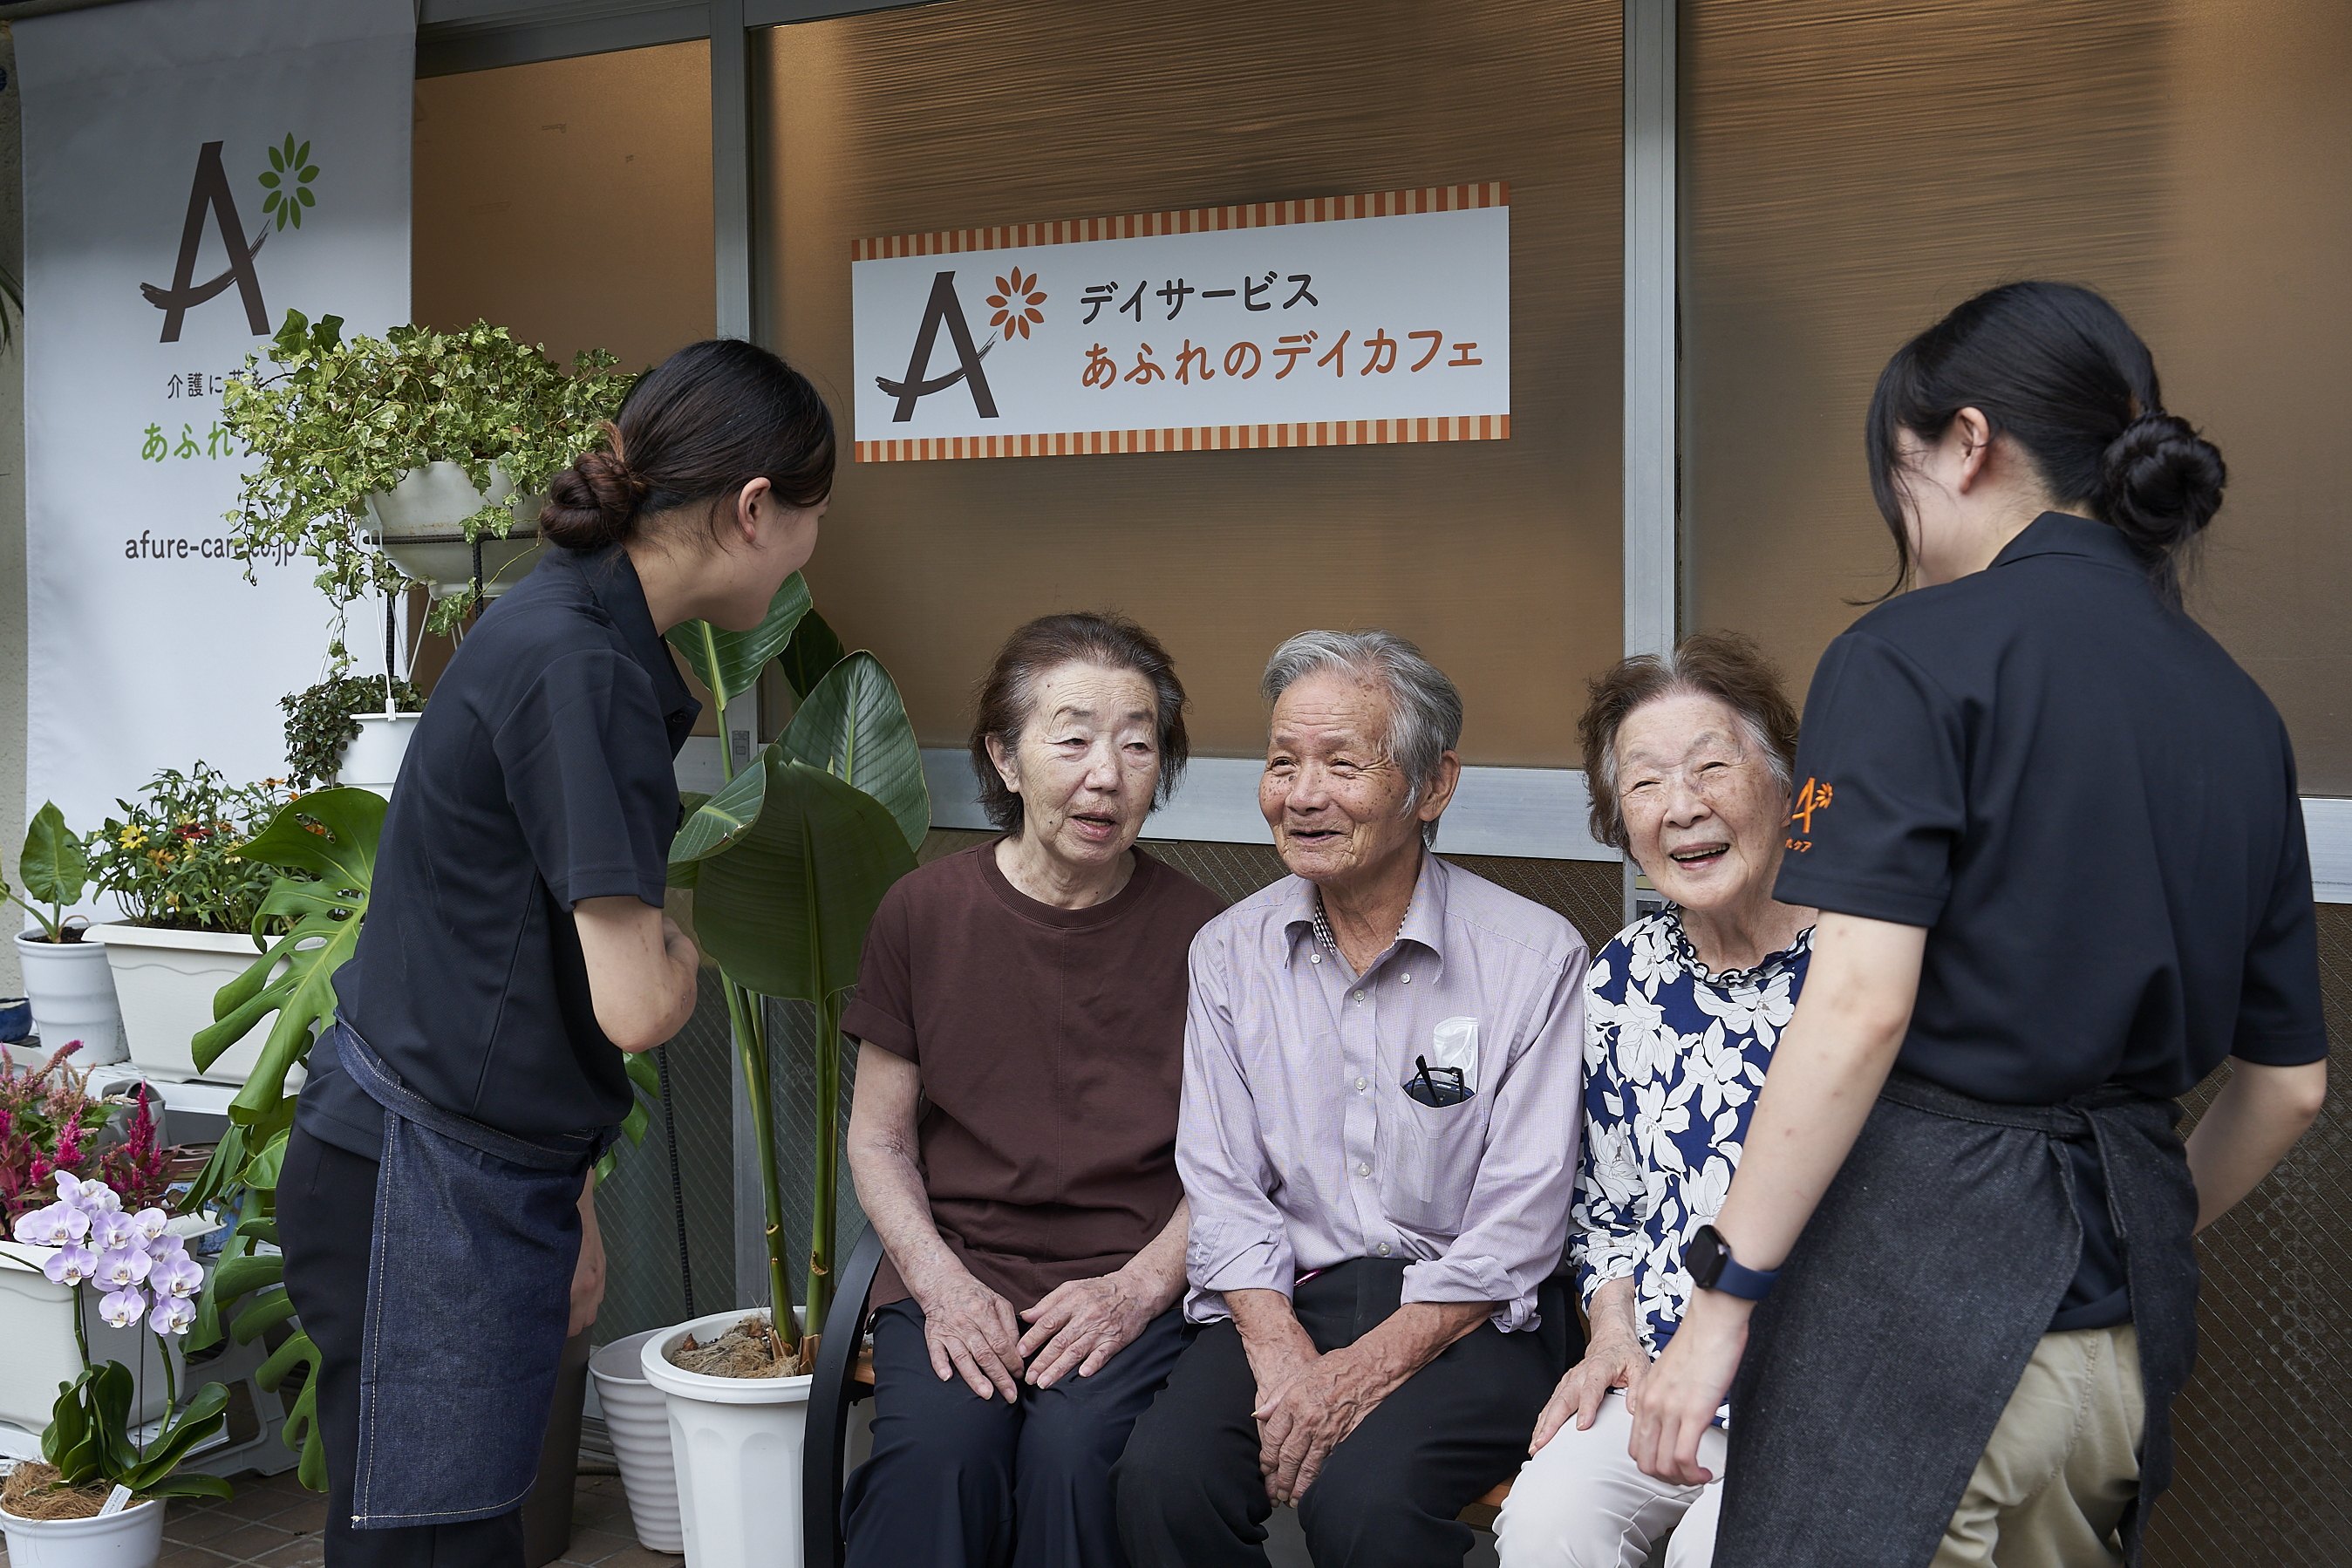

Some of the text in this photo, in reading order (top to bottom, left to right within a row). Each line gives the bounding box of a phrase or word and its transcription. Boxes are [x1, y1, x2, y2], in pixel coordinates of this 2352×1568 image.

[1080, 270, 1319, 325] デイサービス
[1081, 328, 1484, 391] あふれのデイカフェ
[125, 528, 297, 567] afure-carco.jp
